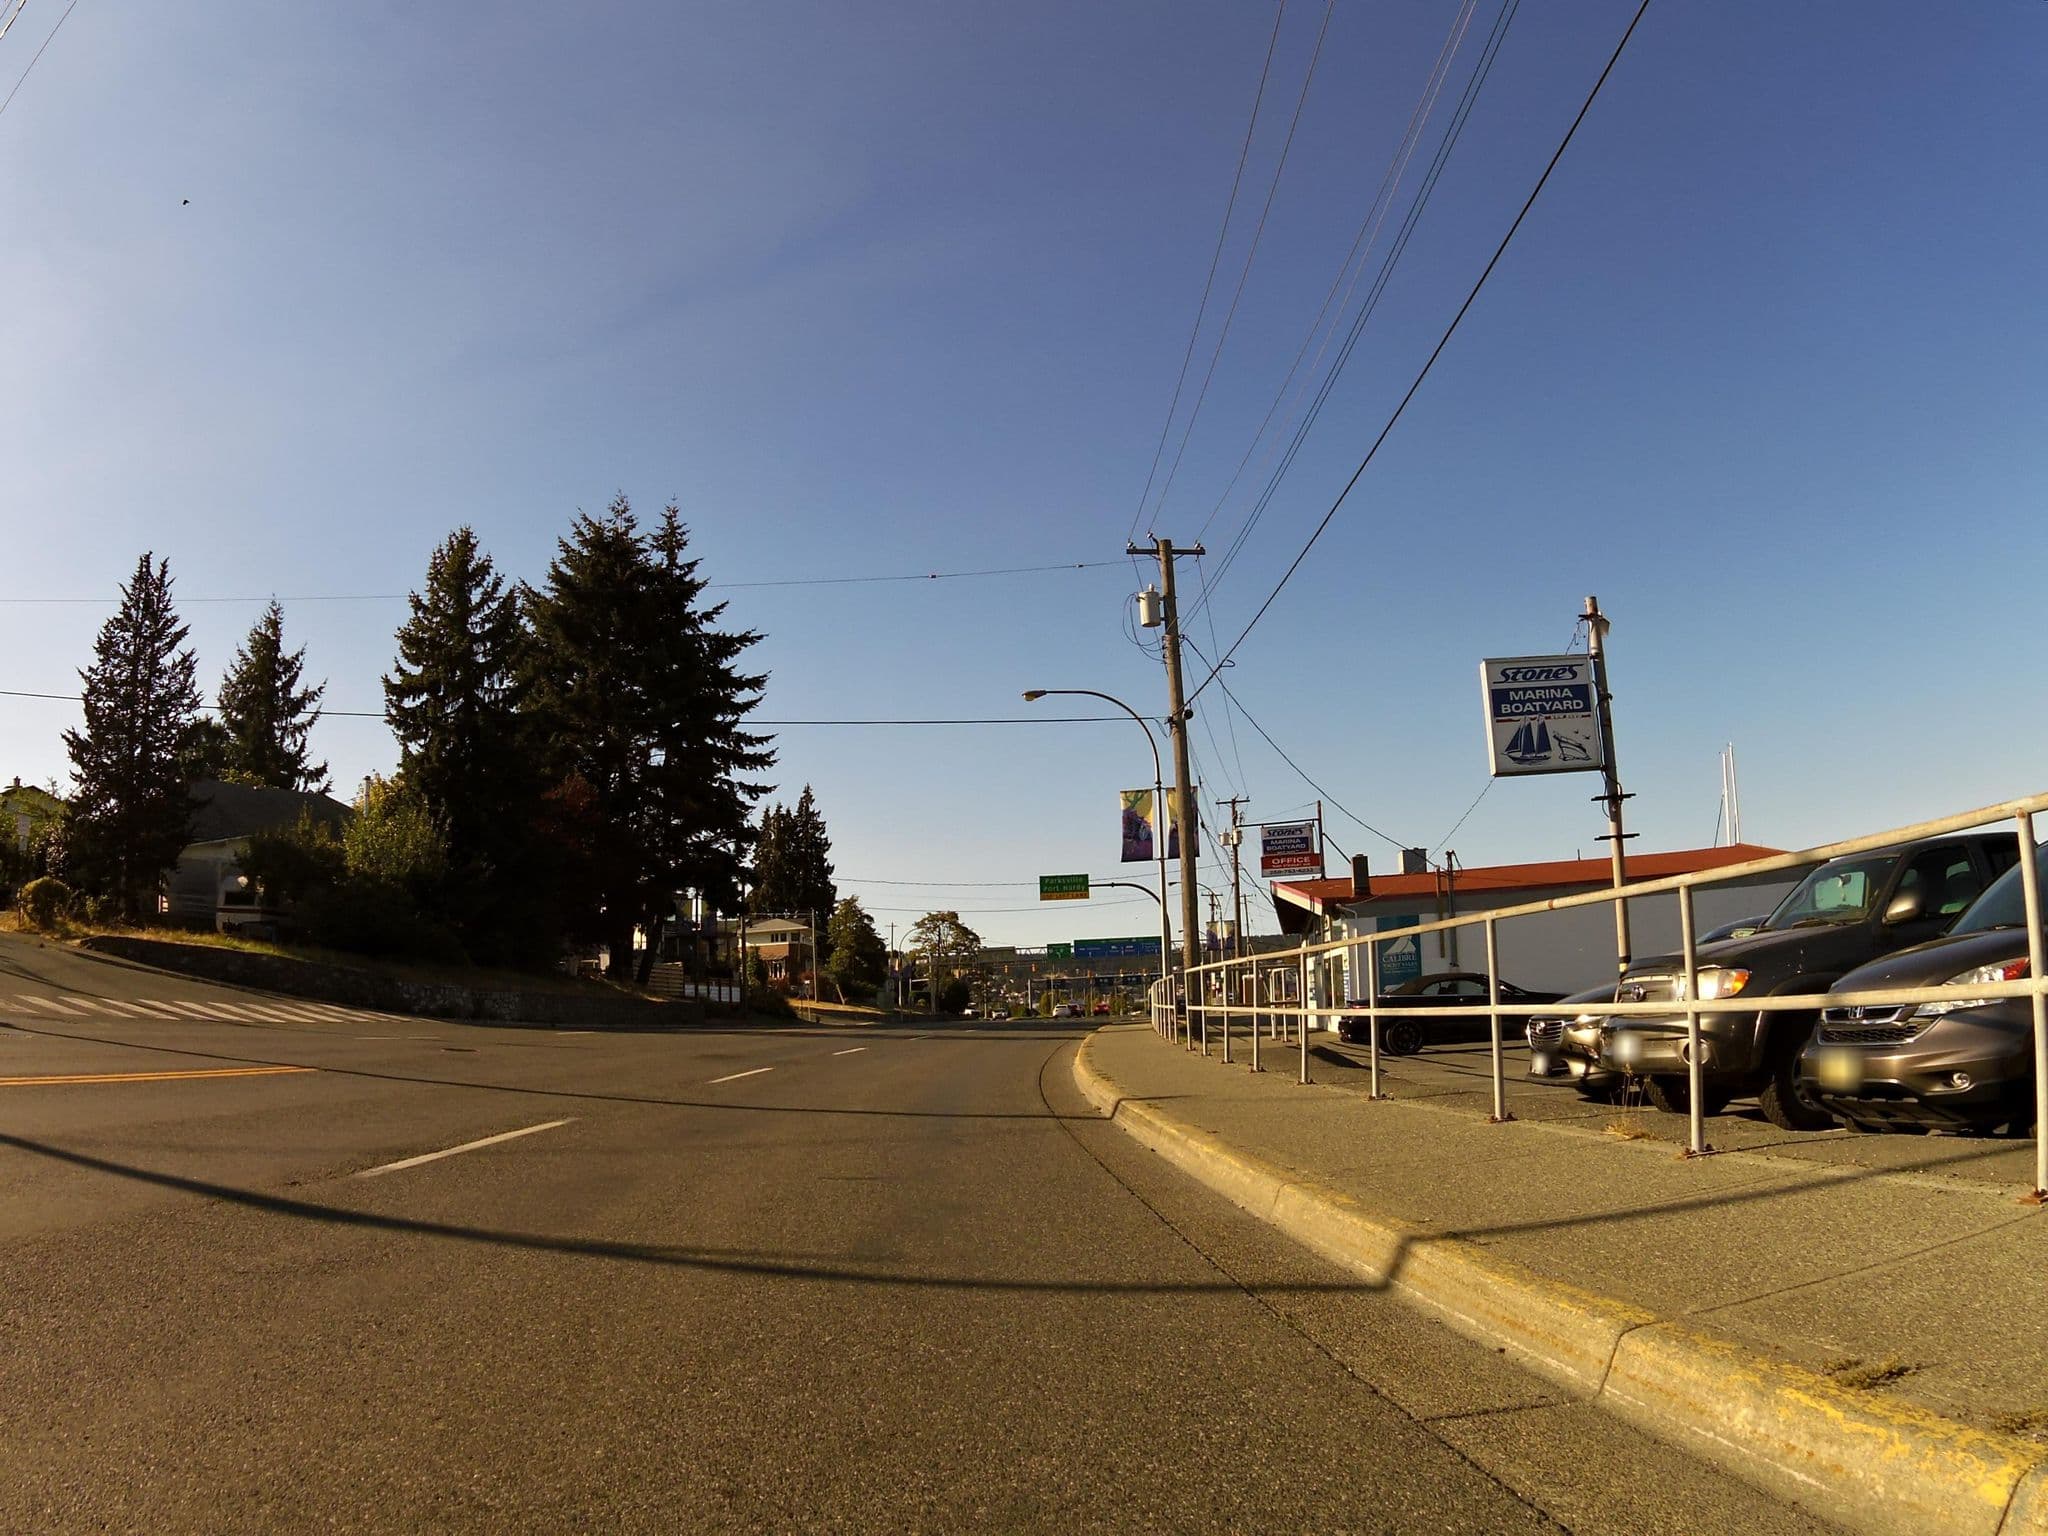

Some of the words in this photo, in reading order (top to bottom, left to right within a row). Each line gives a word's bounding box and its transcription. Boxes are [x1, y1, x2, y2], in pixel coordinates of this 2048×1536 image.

[1509, 688, 1573, 701] MARINA
[1501, 700, 1584, 714] BOATYARD
[1266, 843, 1306, 851] BOATYARD
[1271, 856, 1311, 865] OFFICE
[1044, 876, 1084, 884] Parksville
[1063, 884, 1086, 892] Hardy
[1382, 953, 1417, 963] CALIBRE
